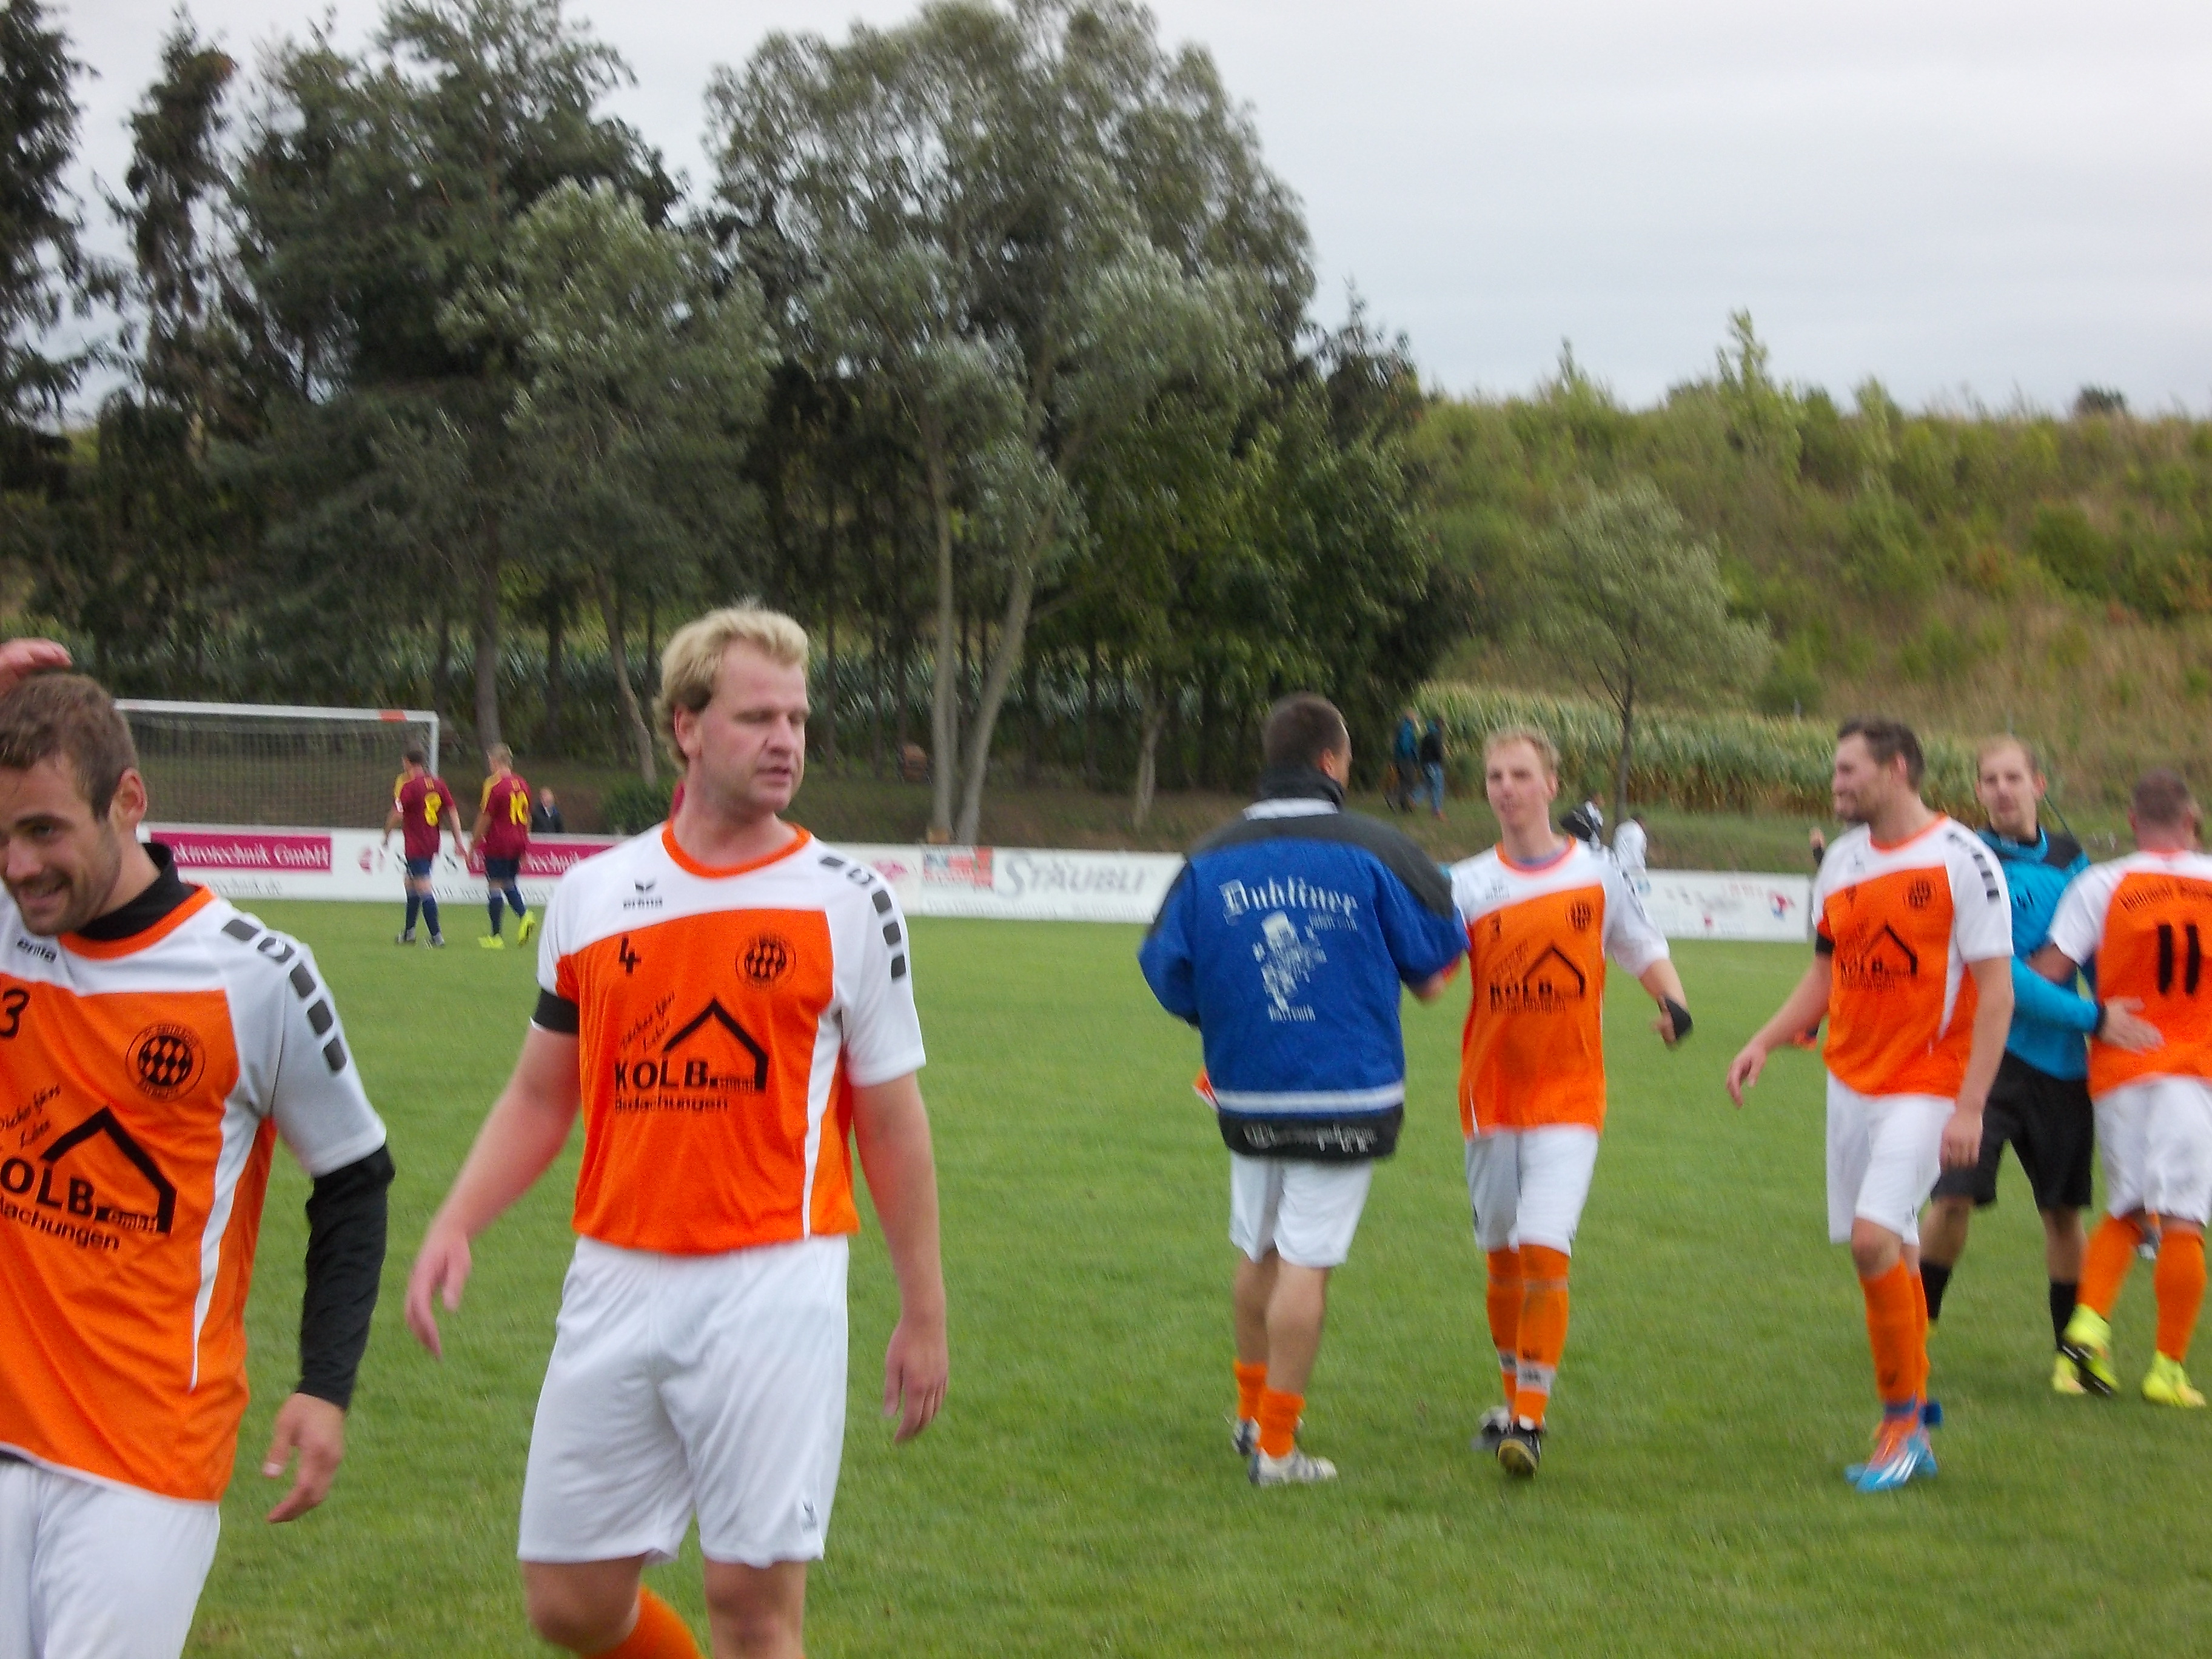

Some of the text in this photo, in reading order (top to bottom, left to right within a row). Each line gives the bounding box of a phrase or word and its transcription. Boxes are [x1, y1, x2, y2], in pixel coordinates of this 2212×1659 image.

[424, 791, 441, 826] 8
[509, 791, 529, 825] 10
[274, 843, 329, 866] GmbH
[619, 936, 642, 974] 4
[2156, 922, 2200, 994] 11
[614, 1059, 708, 1090] KOLB
